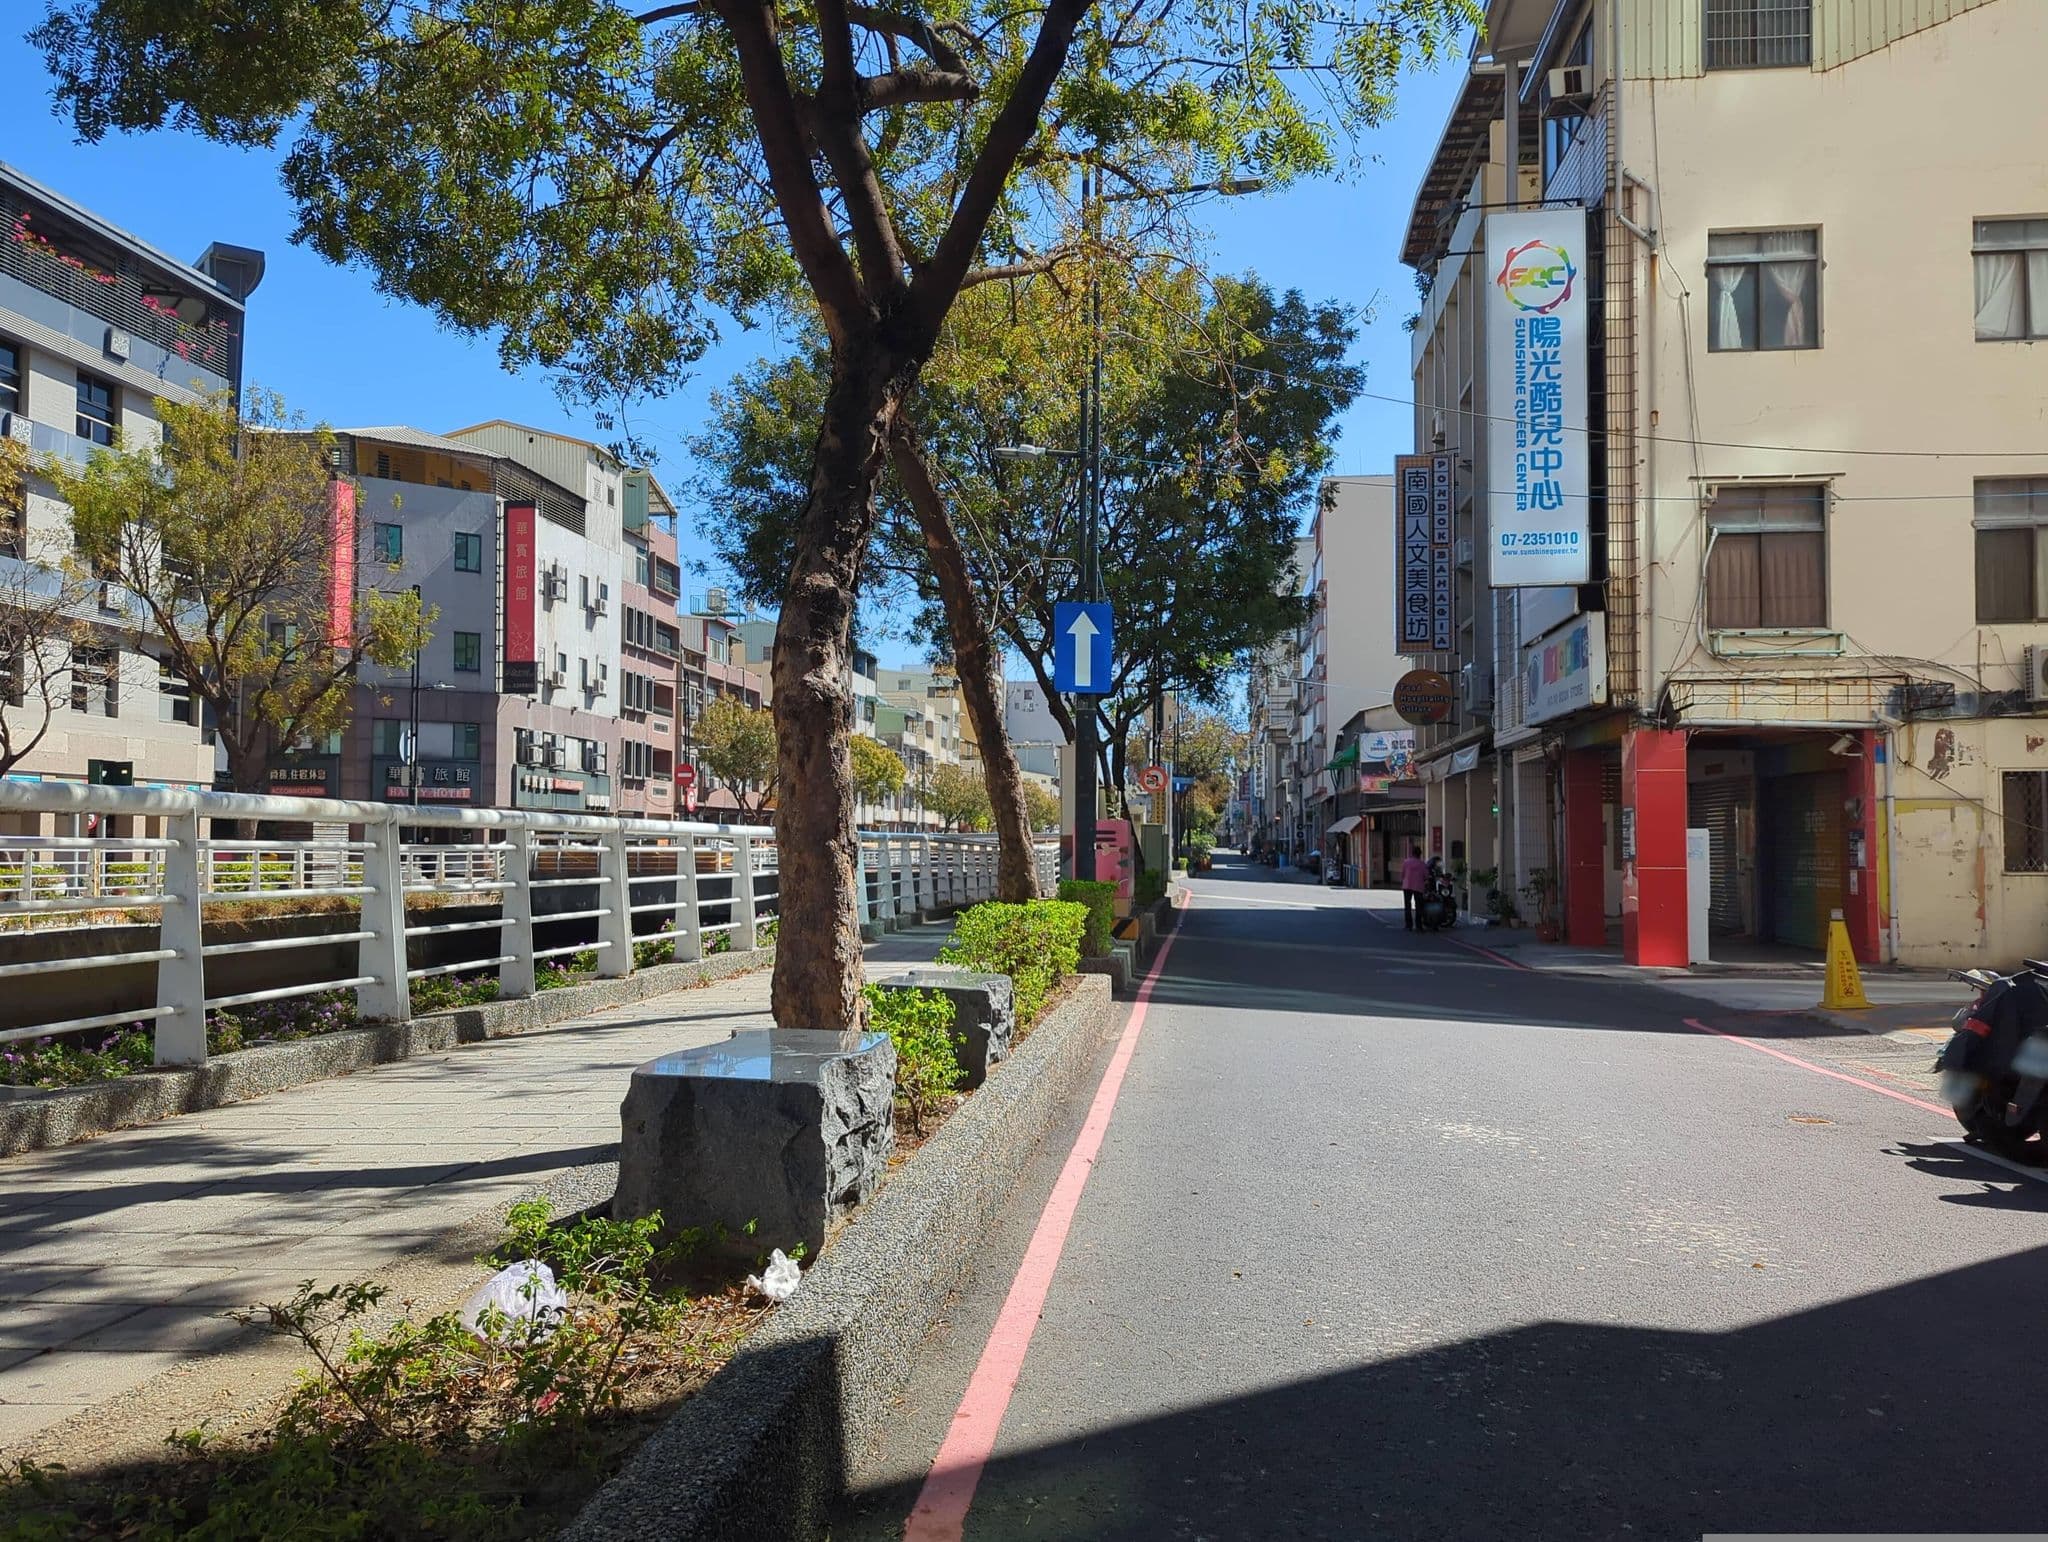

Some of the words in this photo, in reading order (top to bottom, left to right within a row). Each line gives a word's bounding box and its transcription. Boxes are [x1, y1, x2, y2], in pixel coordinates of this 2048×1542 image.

[1514, 318, 1526, 394] SUNSHINE
[1514, 398, 1526, 449] QUEER
[1528, 316, 1563, 511] 陽光酷兒中心
[1437, 460, 1447, 542] PONDOK
[1515, 452, 1527, 512] CENTER
[515, 521, 528, 601] 華賓旅館
[1407, 469, 1429, 639] 南國人文美食坊
[1501, 531, 1579, 546] 07-2351010
[1501, 546, 1579, 557] www.sunshinequeer.tw
[1436, 551, 1447, 646] BAHAGIA
